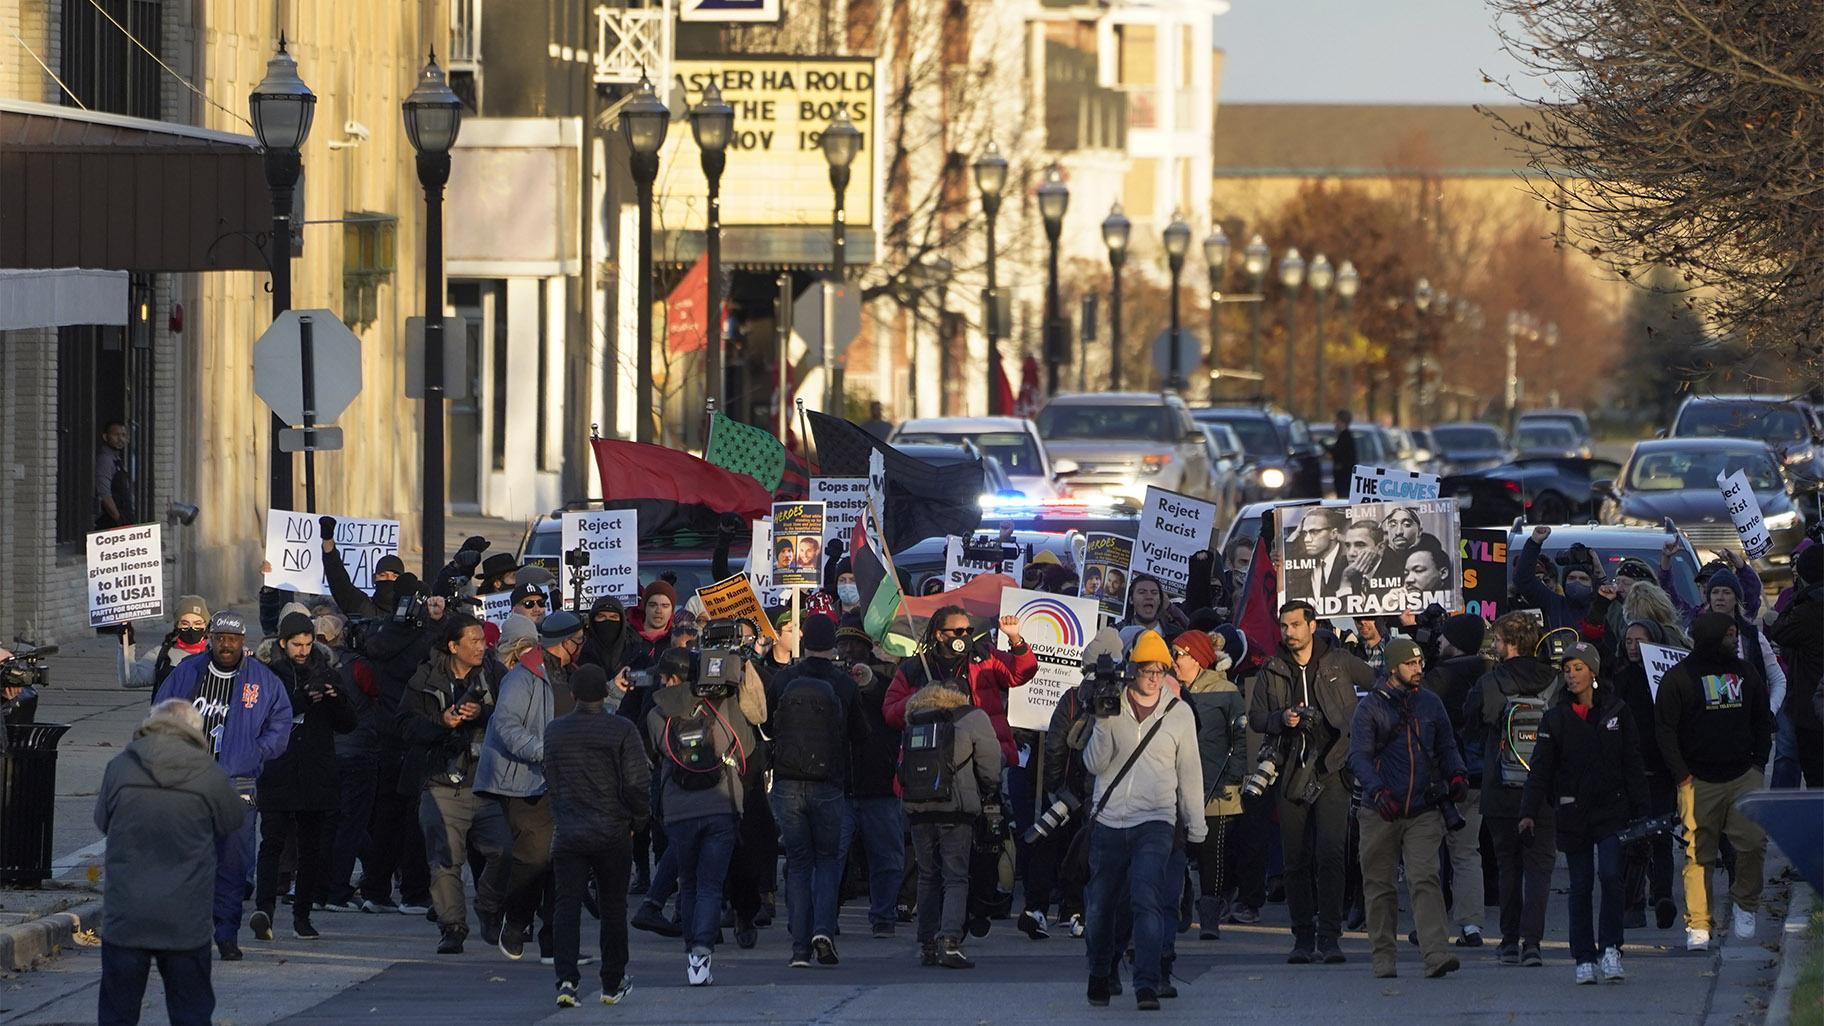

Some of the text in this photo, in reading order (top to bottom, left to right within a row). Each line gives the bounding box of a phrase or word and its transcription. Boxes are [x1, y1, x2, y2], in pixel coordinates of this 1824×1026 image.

[818, 481, 849, 494] Cops
[1355, 476, 1378, 494] THE
[1379, 479, 1437, 500] GLOVES
[1721, 482, 1740, 500] ject
[774, 505, 804, 524] HEROES
[1158, 498, 1200, 520] Reject
[1346, 506, 1376, 518] BLM!
[1420, 502, 1450, 514] BLM!
[1728, 498, 1748, 514] cist
[286, 517, 398, 545] NO USTICE
[578, 518, 622, 534] Reject
[1155, 516, 1196, 538] Racist
[1738, 515, 1760, 534] ante
[96, 529, 151, 546] Cops and
[579, 537, 621, 550] Racist
[1744, 533, 1762, 548] ror
[100, 547, 148, 561] fascists
[283, 549, 311, 570] NO
[1141, 540, 1192, 564] Vigilan
[1460, 539, 1506, 563] KYLE
[90, 560, 159, 578] given license
[1286, 559, 1316, 570] BLM!
[98, 574, 152, 591] to kill in
[1370, 577, 1401, 588] BLM!
[1464, 569, 1477, 588] S
[96, 586, 155, 606] the USA!
[573, 583, 624, 594] error
[713, 596, 725, 604] the
[726, 586, 749, 599] Name
[92, 608, 112, 617] PARTY
[126, 601, 160, 611] SOCIALISM
[717, 596, 755, 614] Humanity,
[1347, 590, 1451, 614] RACISM!
[1466, 600, 1496, 620] OM
[115, 609, 151, 619] LIBERATION
[1038, 656, 1077, 666] LITION
[1030, 678, 1060, 688] JUSTICE
[1029, 687, 1060, 698] FOR THE
